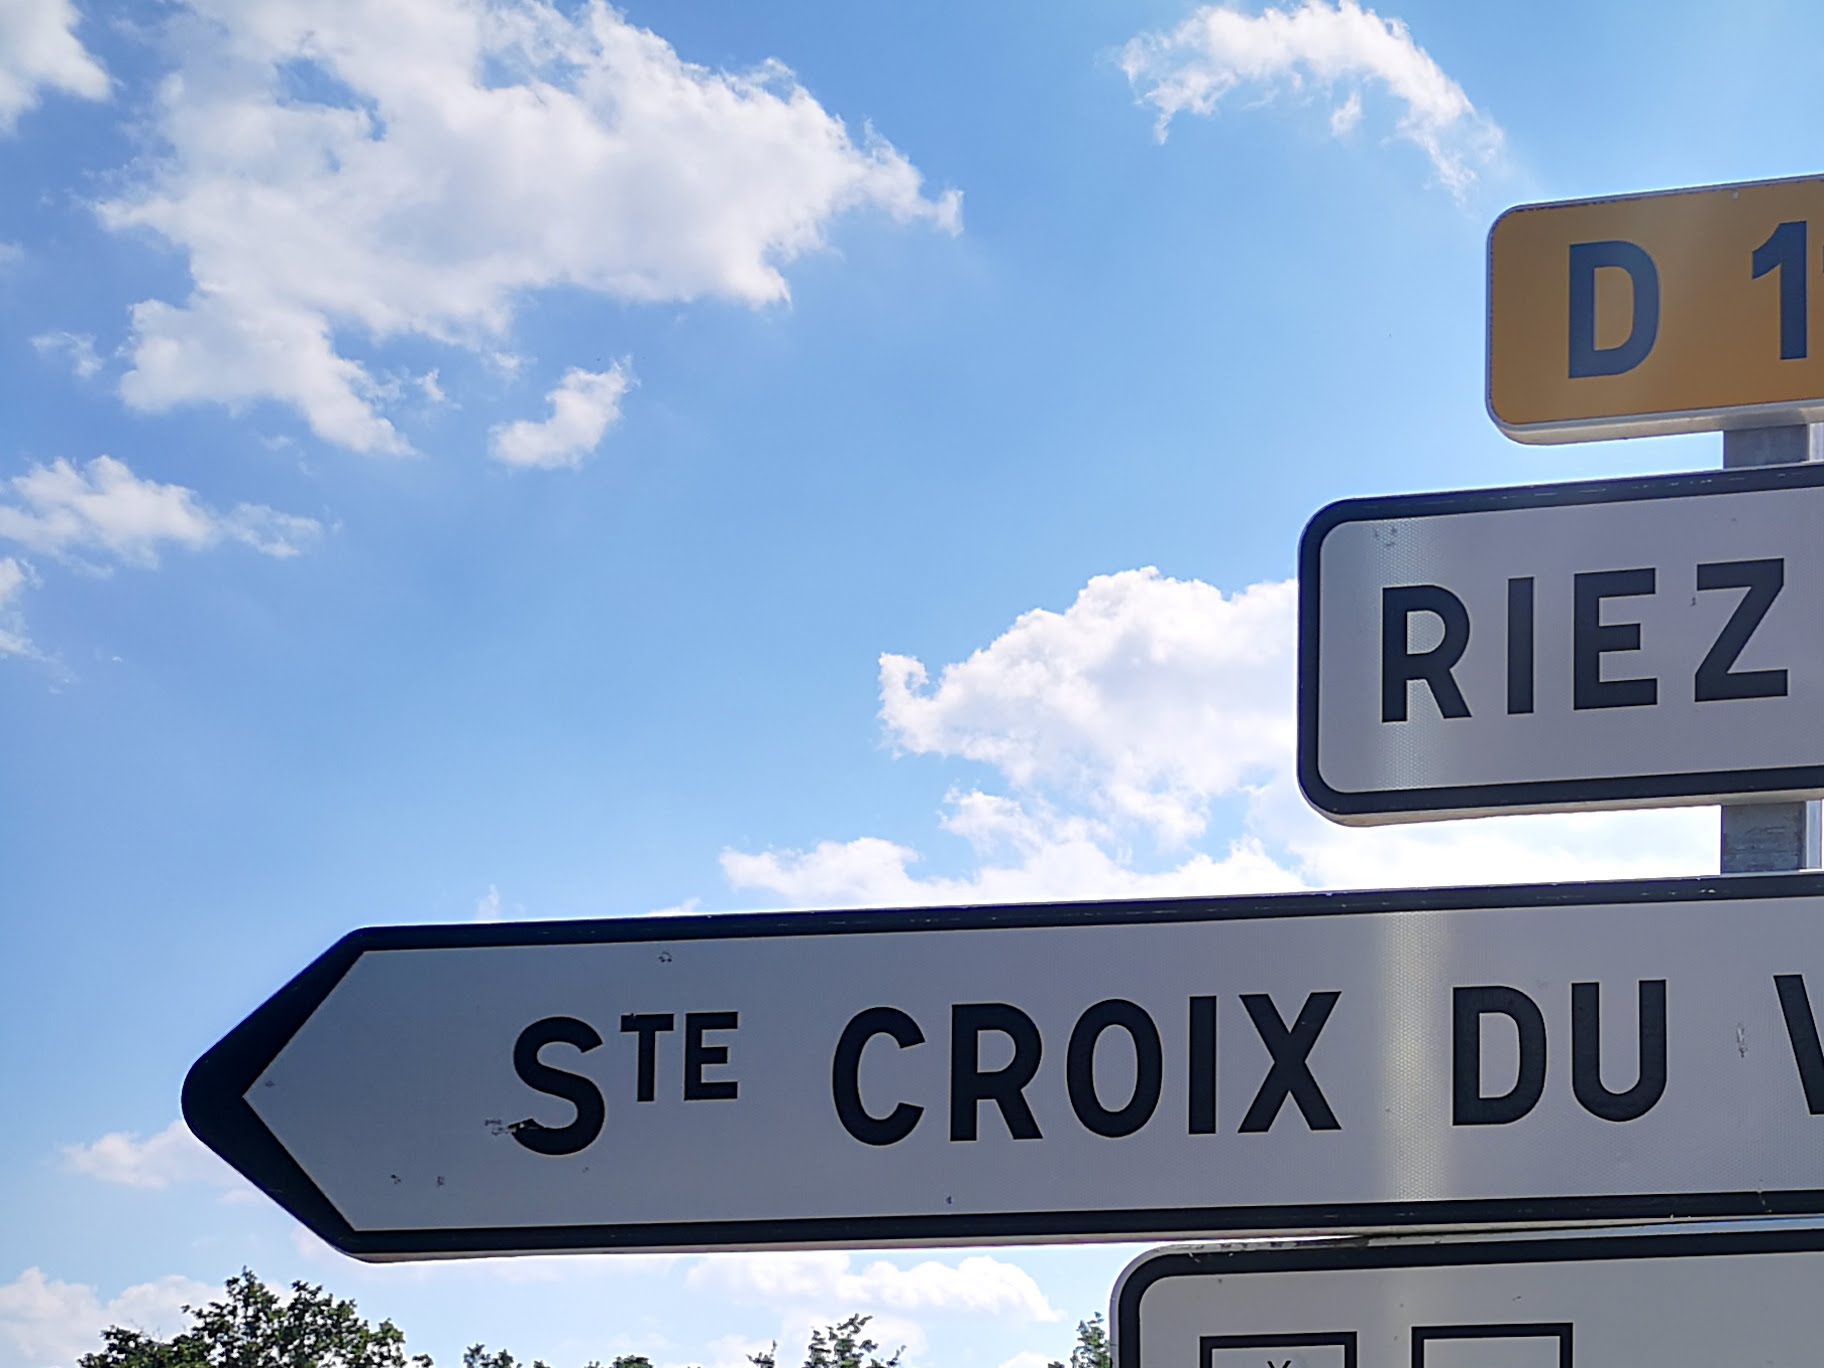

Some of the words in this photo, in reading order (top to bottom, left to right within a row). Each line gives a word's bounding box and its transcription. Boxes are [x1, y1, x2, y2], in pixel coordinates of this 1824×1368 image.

[1568, 241, 1659, 379] D
[1382, 558, 1788, 723] RIEZ
[509, 1012, 738, 1155] STE
[833, 991, 1341, 1146] CROIX
[1453, 979, 1667, 1126] DU
